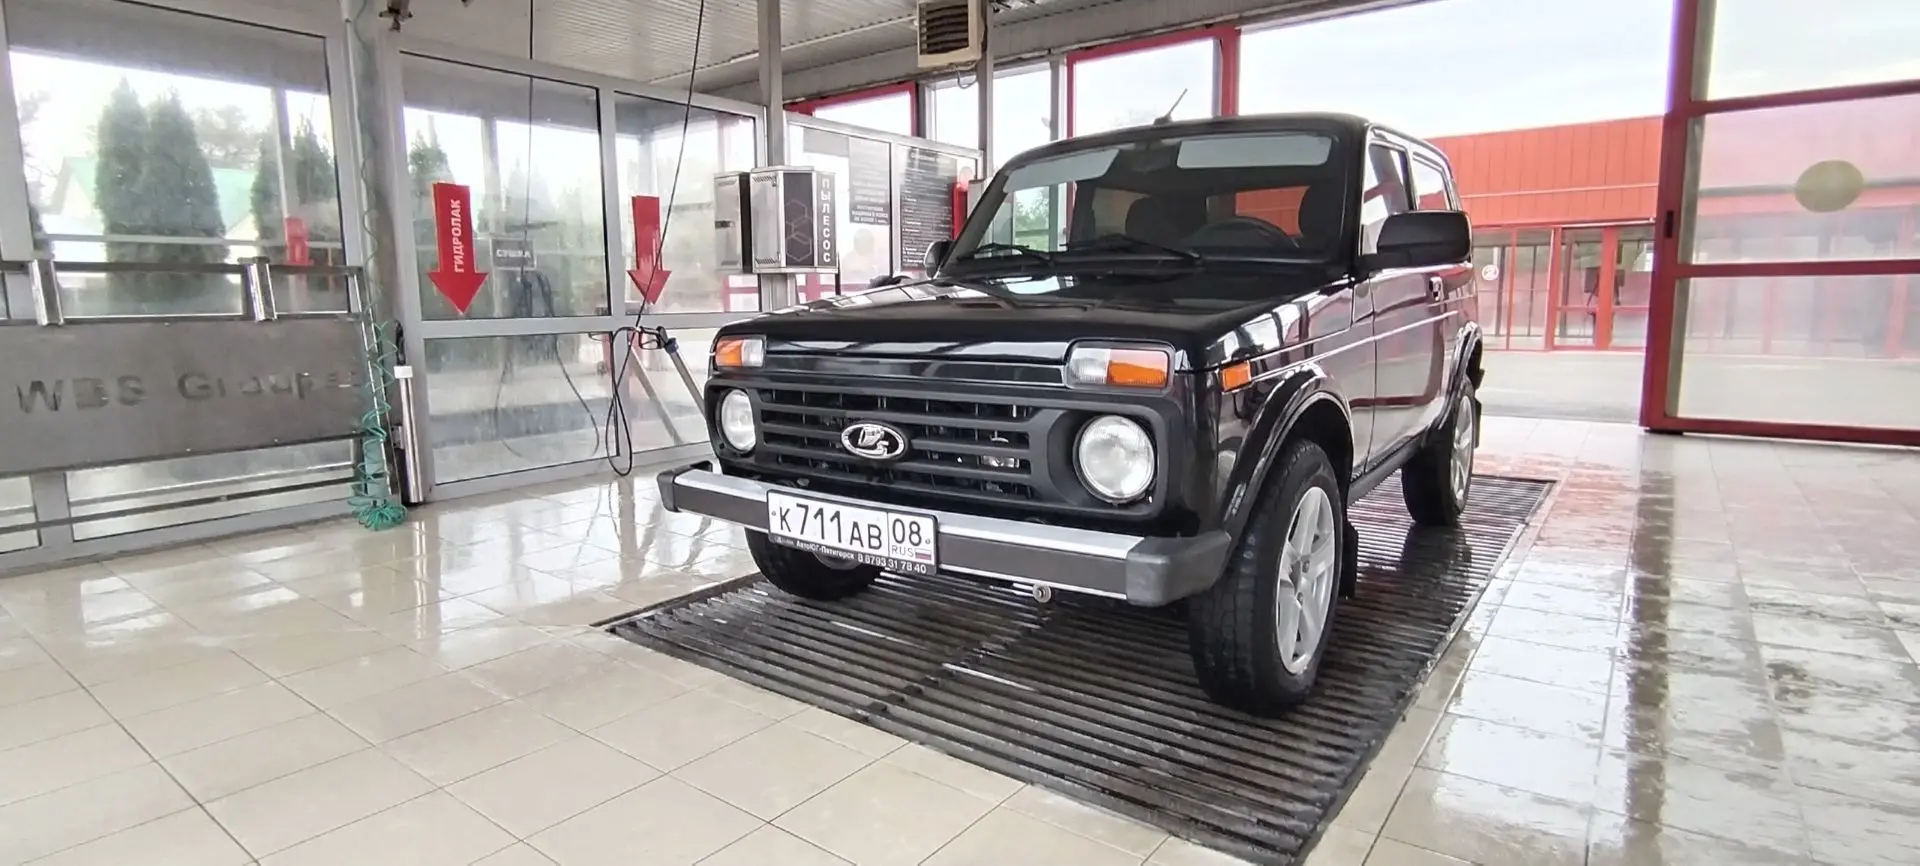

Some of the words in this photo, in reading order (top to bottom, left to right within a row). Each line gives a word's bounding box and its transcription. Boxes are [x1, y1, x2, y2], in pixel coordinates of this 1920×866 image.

[821, 178, 831, 263] ПЫЛЕСОС
[450, 199, 465, 273] ГИДРОЛАК
[892, 518, 922, 547] 08
[888, 558, 898, 569] 31
[914, 564, 927, 574] 40
[892, 545, 914, 558] RUS
